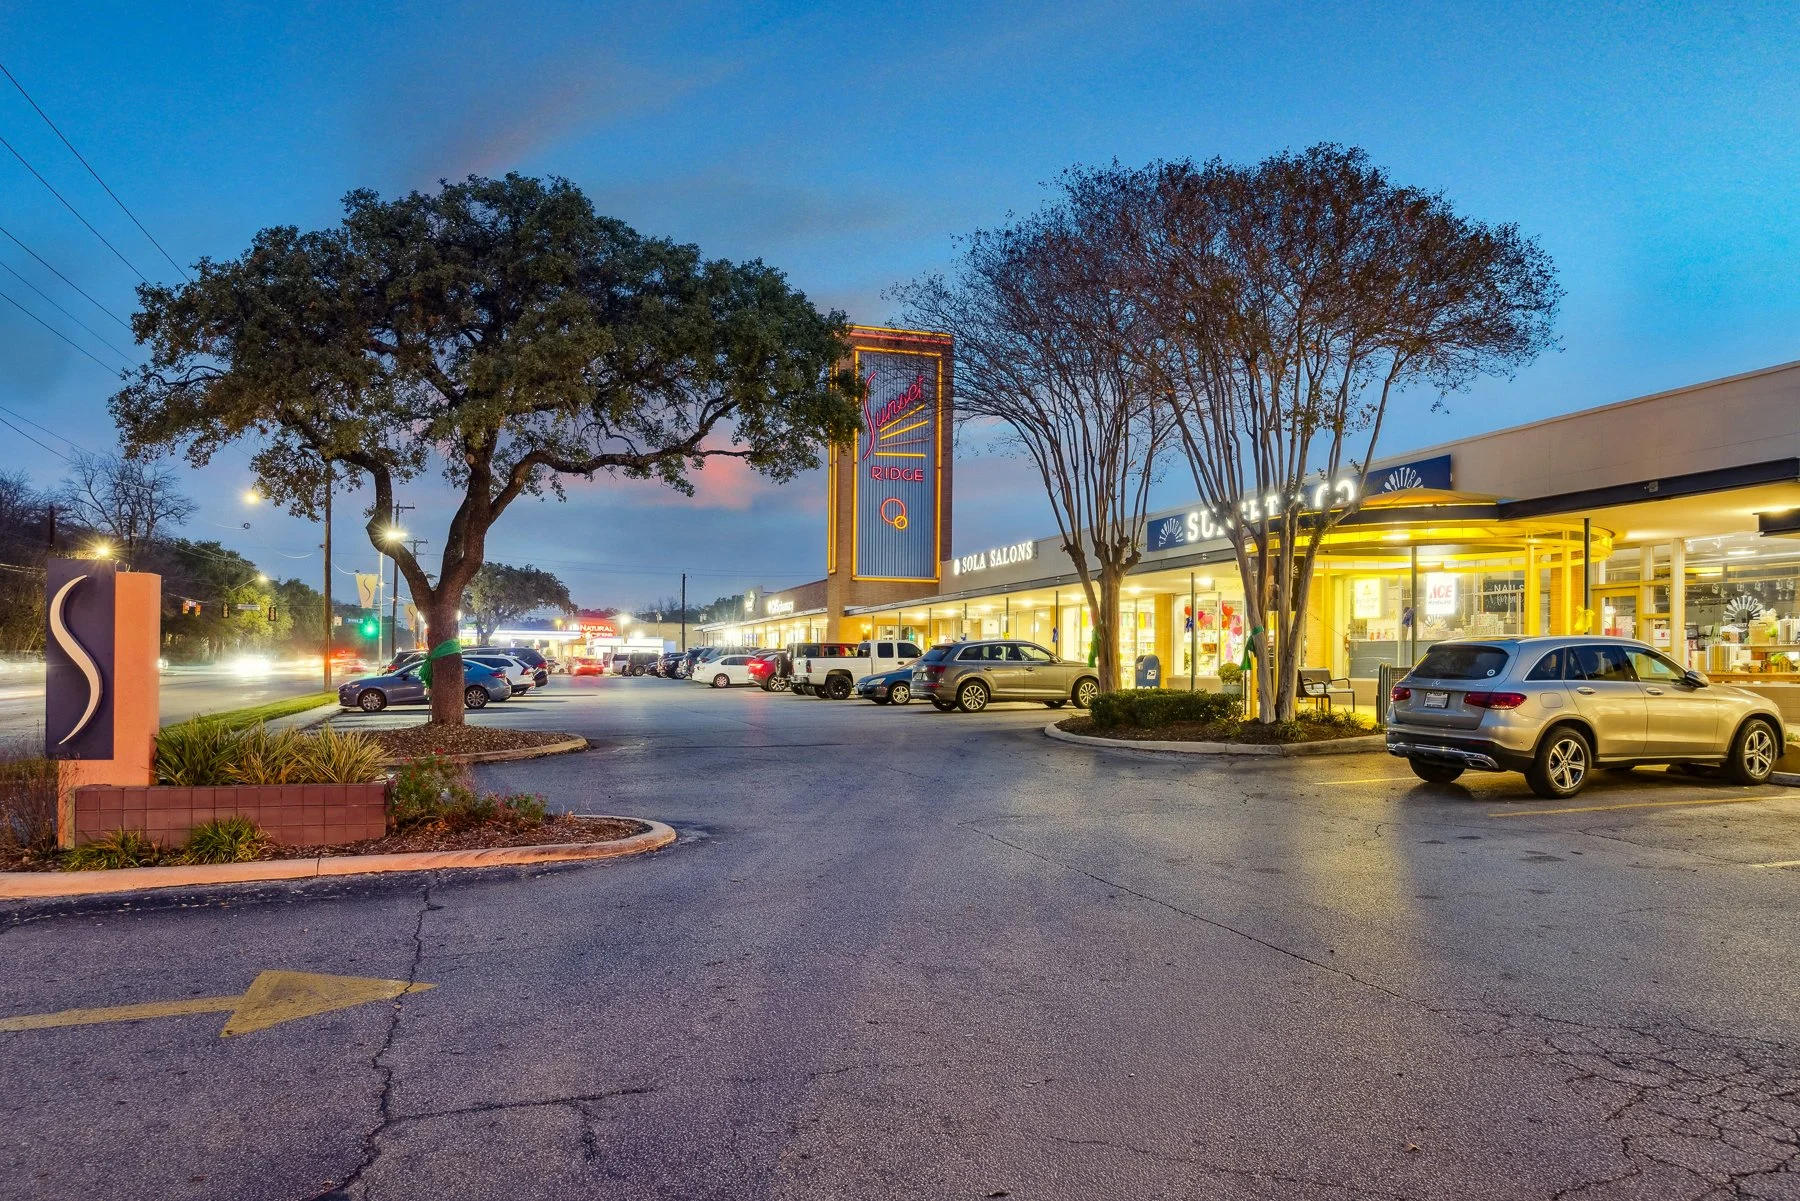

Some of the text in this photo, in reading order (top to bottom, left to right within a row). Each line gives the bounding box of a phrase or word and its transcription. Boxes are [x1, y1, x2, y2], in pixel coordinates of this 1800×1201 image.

[863, 371, 924, 462] Sunset
[871, 465, 924, 481] RIDGE
[962, 541, 1034, 574] SOLA SALONS
[1429, 585, 1453, 599] ACE
[1493, 584, 1525, 593] NAILS
[579, 624, 614, 632] NATURAL
